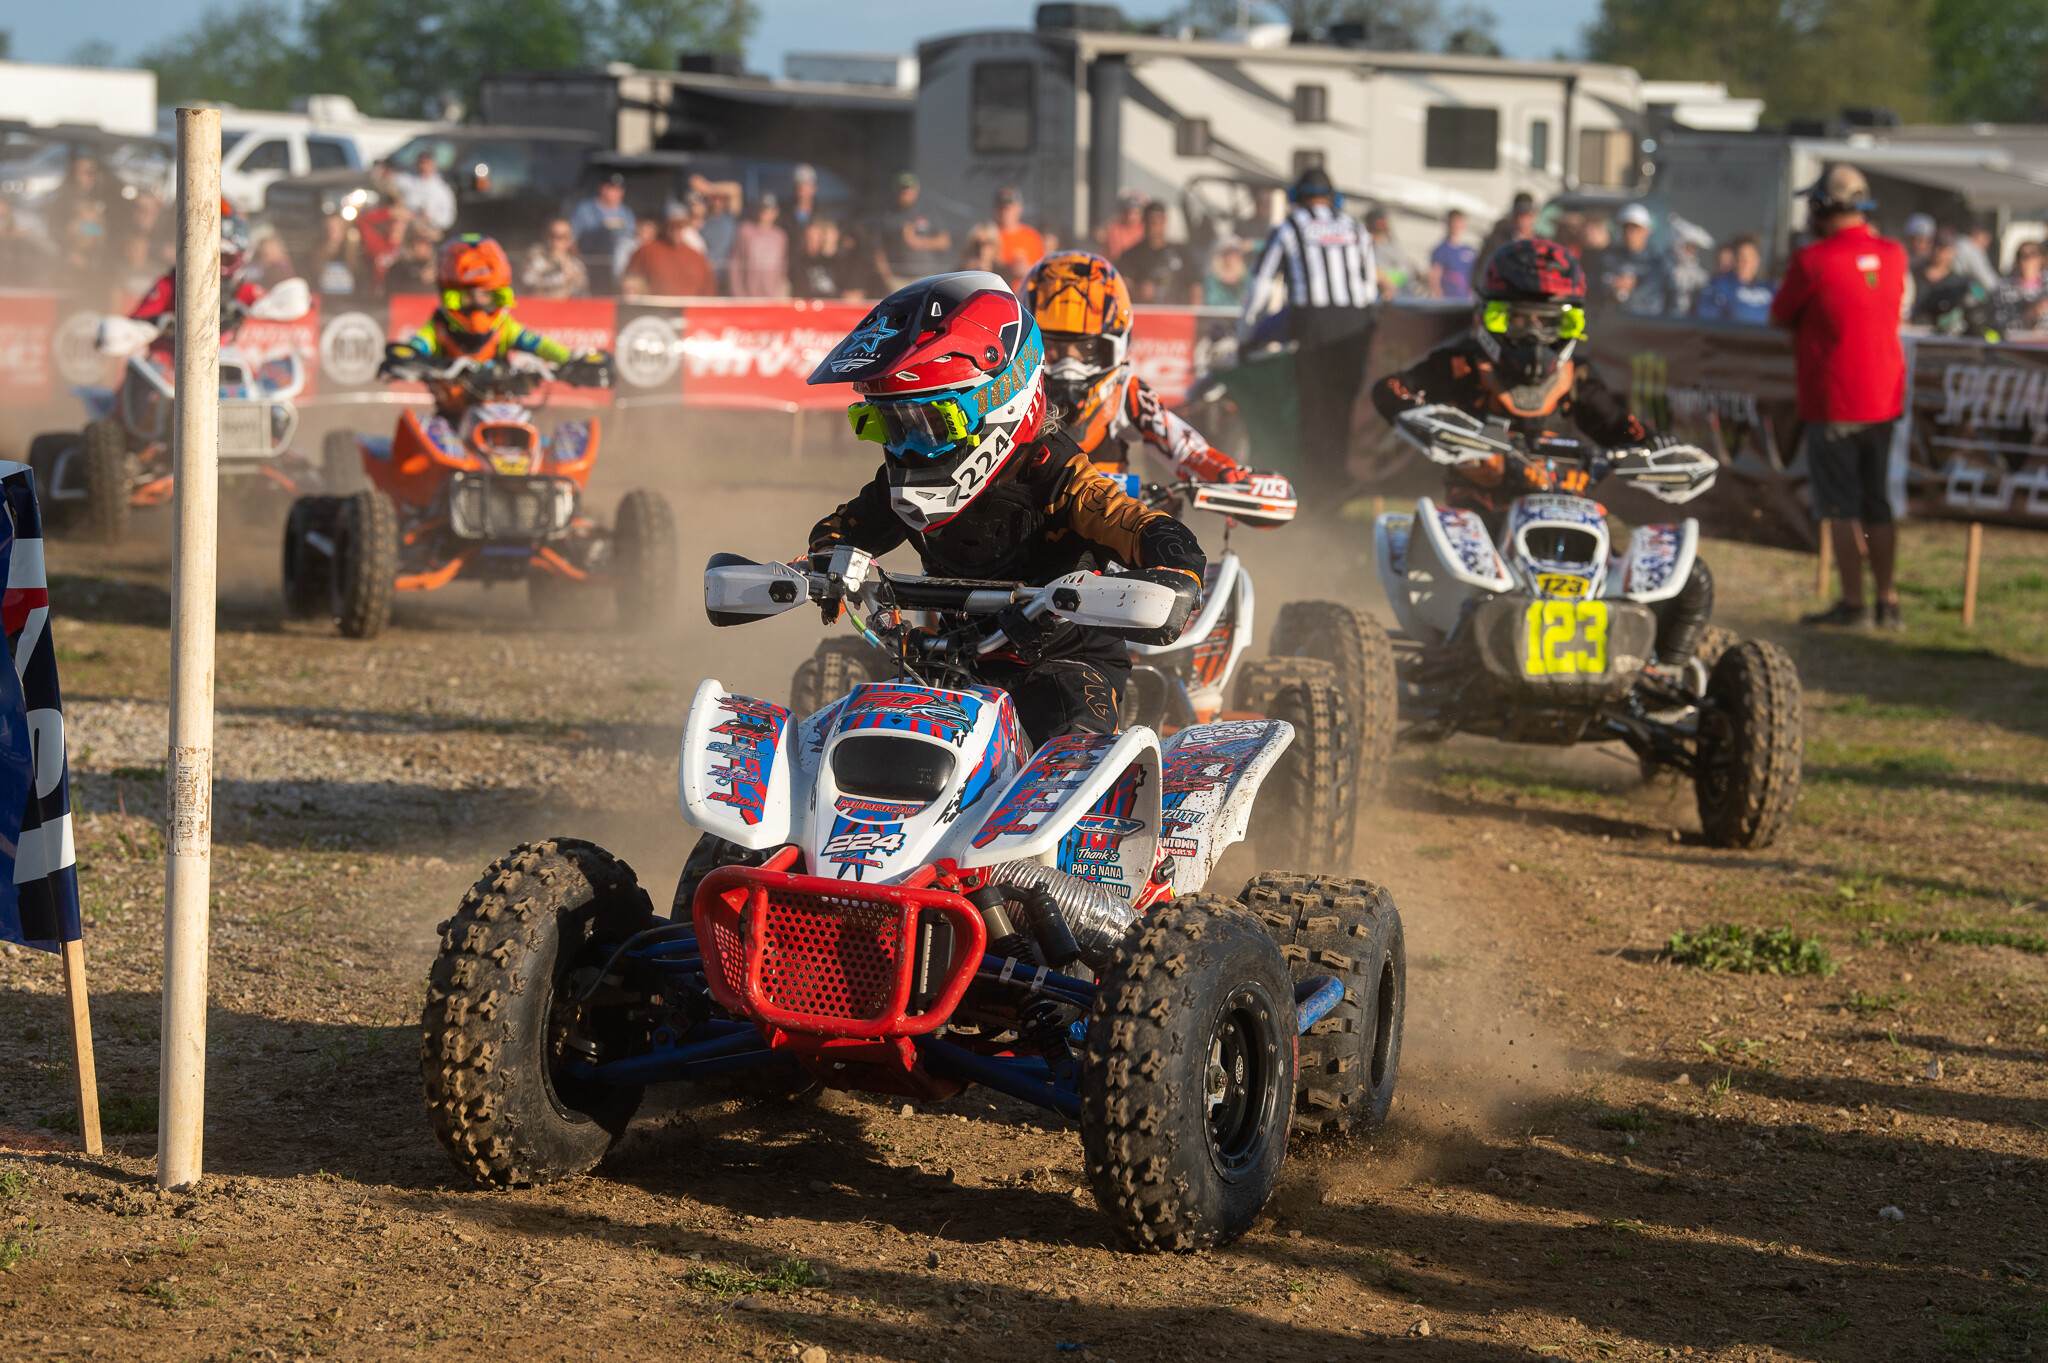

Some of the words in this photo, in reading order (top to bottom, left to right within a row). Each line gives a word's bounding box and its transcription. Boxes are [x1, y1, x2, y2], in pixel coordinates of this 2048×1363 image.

[972, 335, 1039, 416] 100%
[1026, 379, 1043, 426] FLY
[959, 434, 1010, 491] 224
[1251, 478, 1288, 498] 703
[1542, 577, 1583, 596] 123
[1526, 600, 1609, 675] 123
[707, 792, 760, 808] KENDA
[839, 799, 919, 815] MURRICA!!
[985, 824, 1037, 834] KENDA
[823, 833, 904, 855] 224
[1079, 848, 1119, 861] Thank's
[1071, 864, 1088, 875] PAP
[1090, 865, 1097, 875] &
[1098, 866, 1122, 880] NANA
